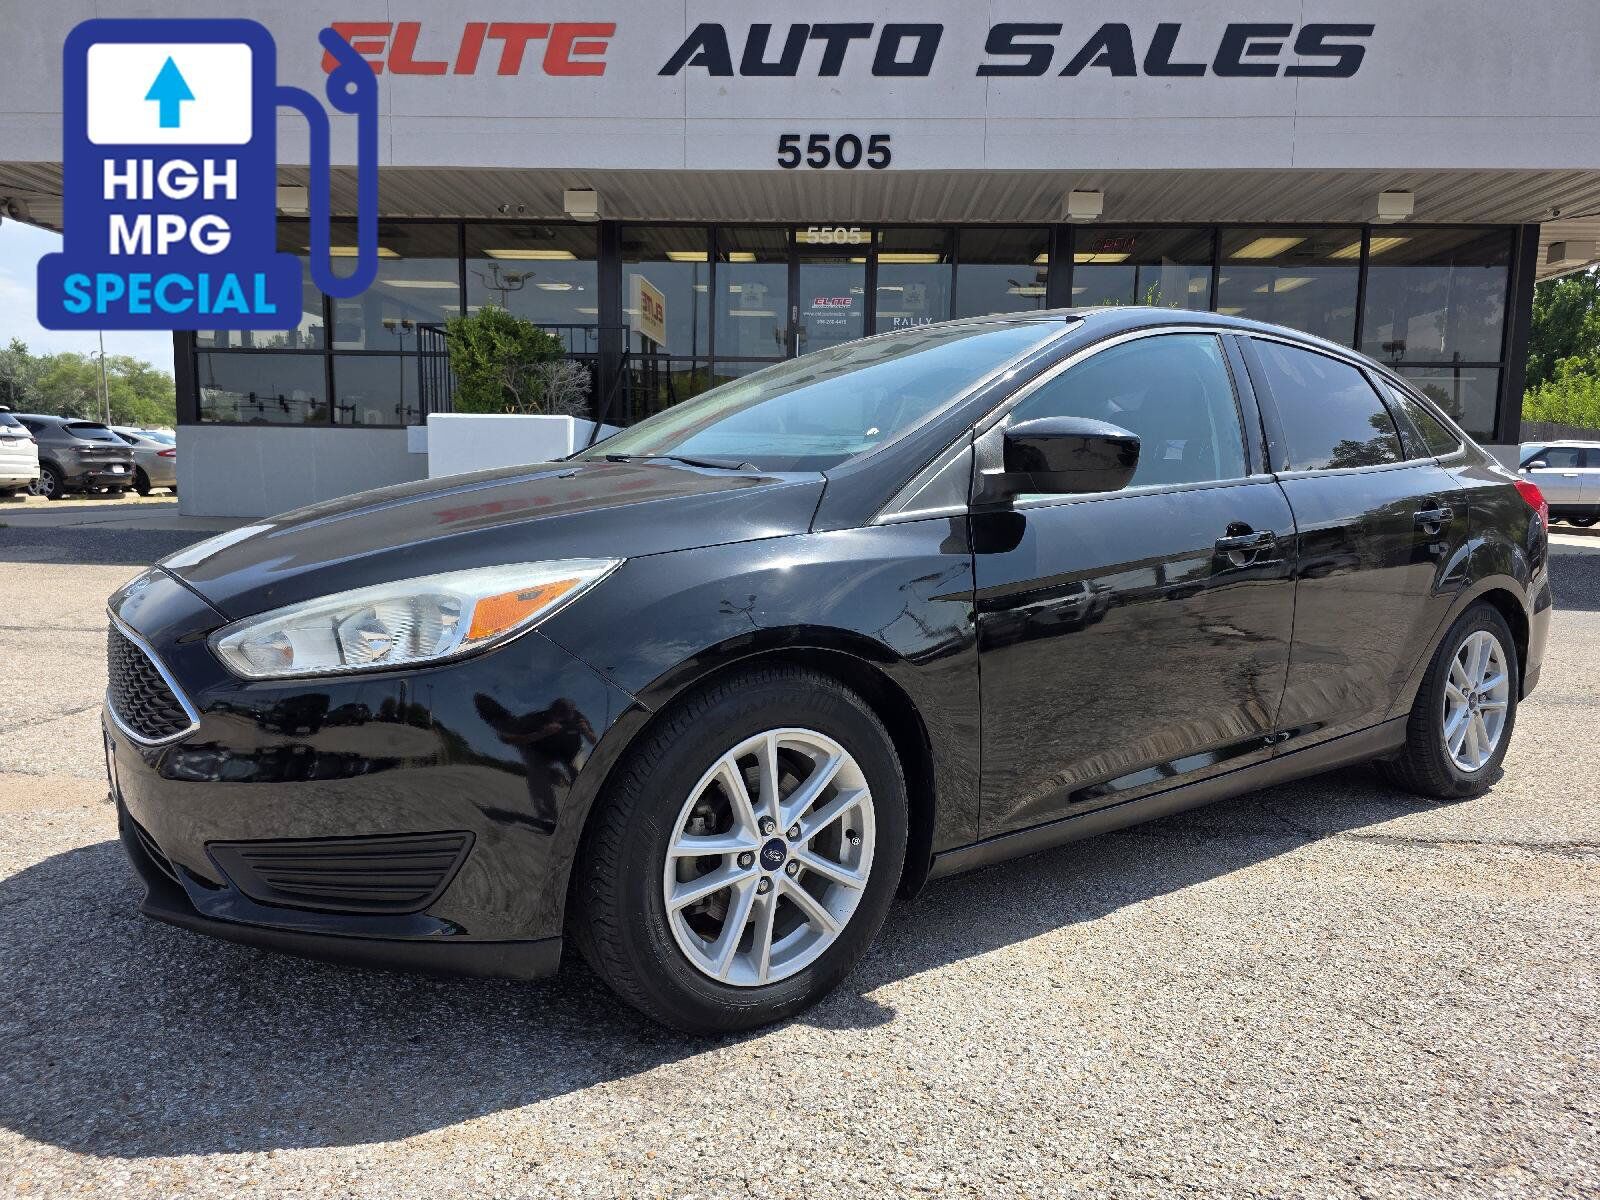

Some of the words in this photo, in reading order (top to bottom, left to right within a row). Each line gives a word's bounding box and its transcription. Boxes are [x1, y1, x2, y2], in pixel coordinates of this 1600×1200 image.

[657, 22, 945, 77] AUTO
[975, 22, 1376, 77] SALES
[777, 133, 892, 169] 5505
[807, 227, 861, 244] 5505
[893, 317, 933, 326] RALLY
